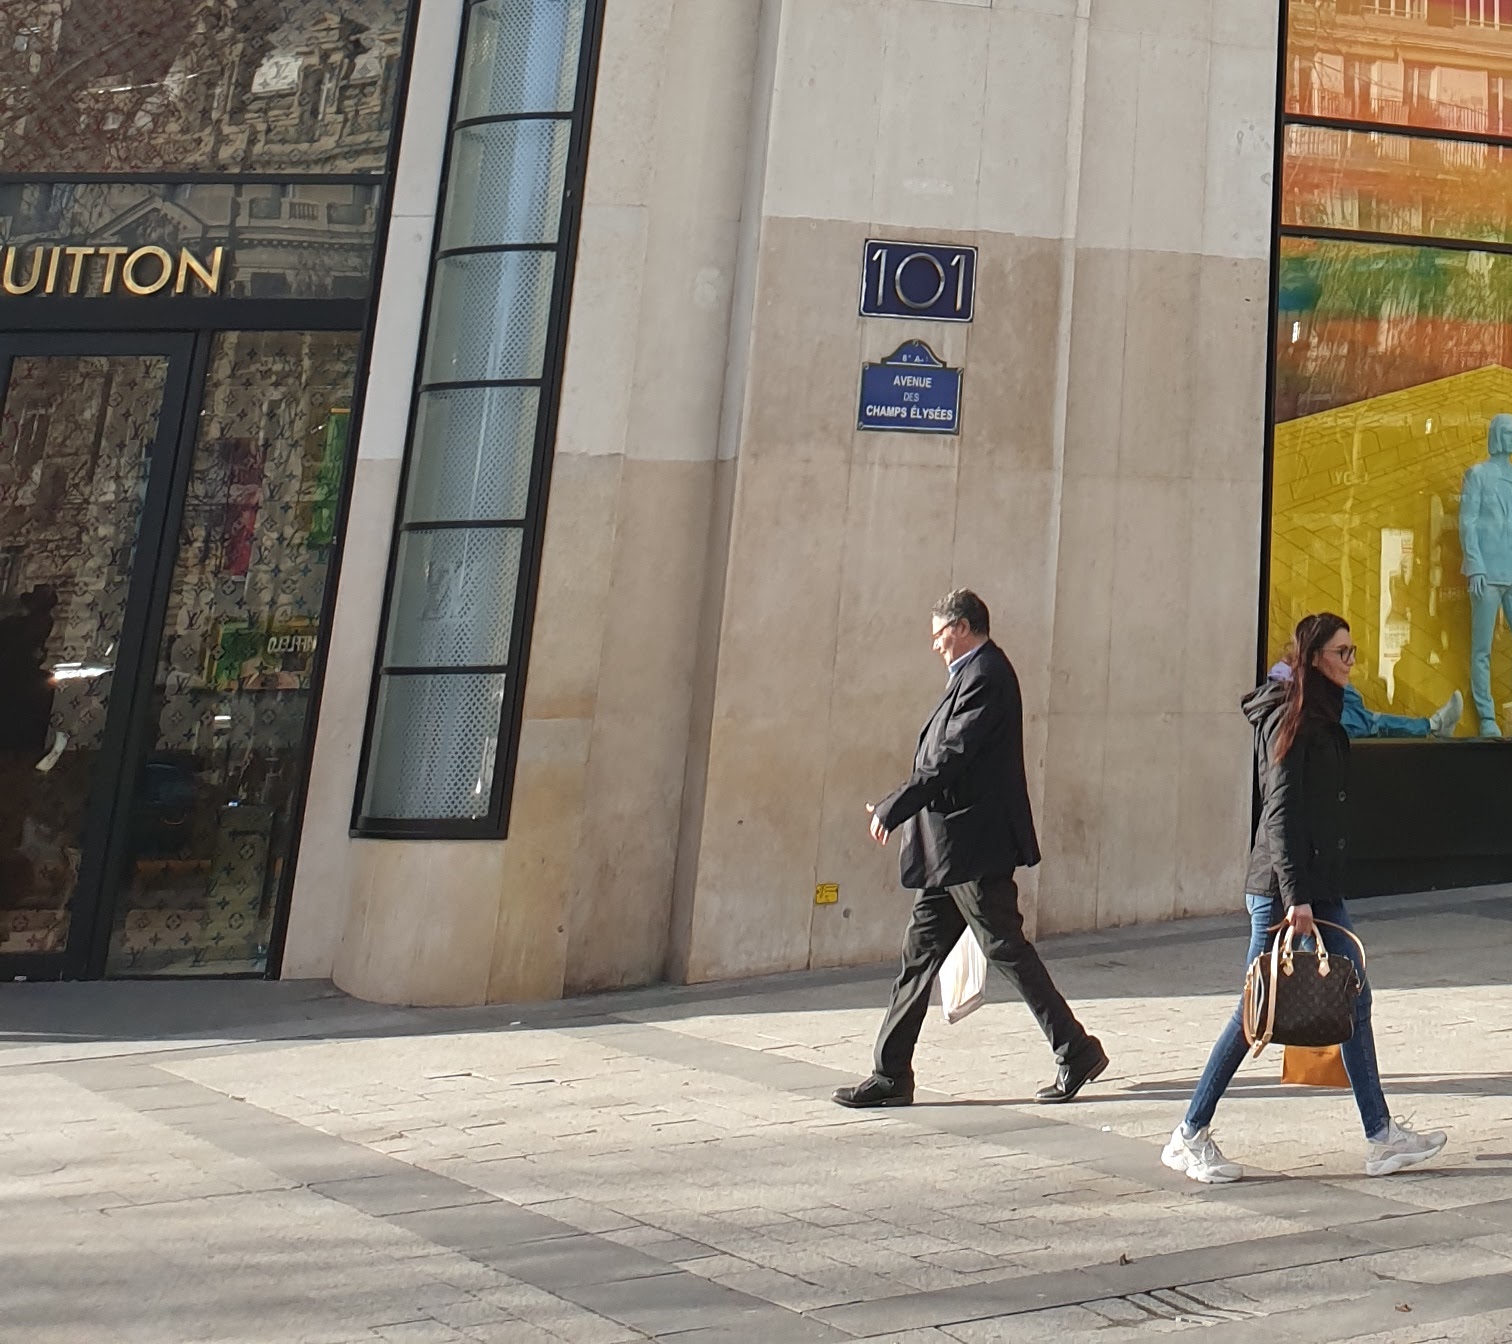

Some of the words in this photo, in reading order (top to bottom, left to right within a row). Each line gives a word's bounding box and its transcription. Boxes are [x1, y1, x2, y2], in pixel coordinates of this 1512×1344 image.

[0, 245, 223, 295] UITTON
[872, 249, 966, 311] 101
[893, 375, 932, 388] AVENUE
[903, 392, 920, 402] DES
[866, 404, 907, 418] CHAMPS
[910, 405, 953, 421] ÉLYSÉES
